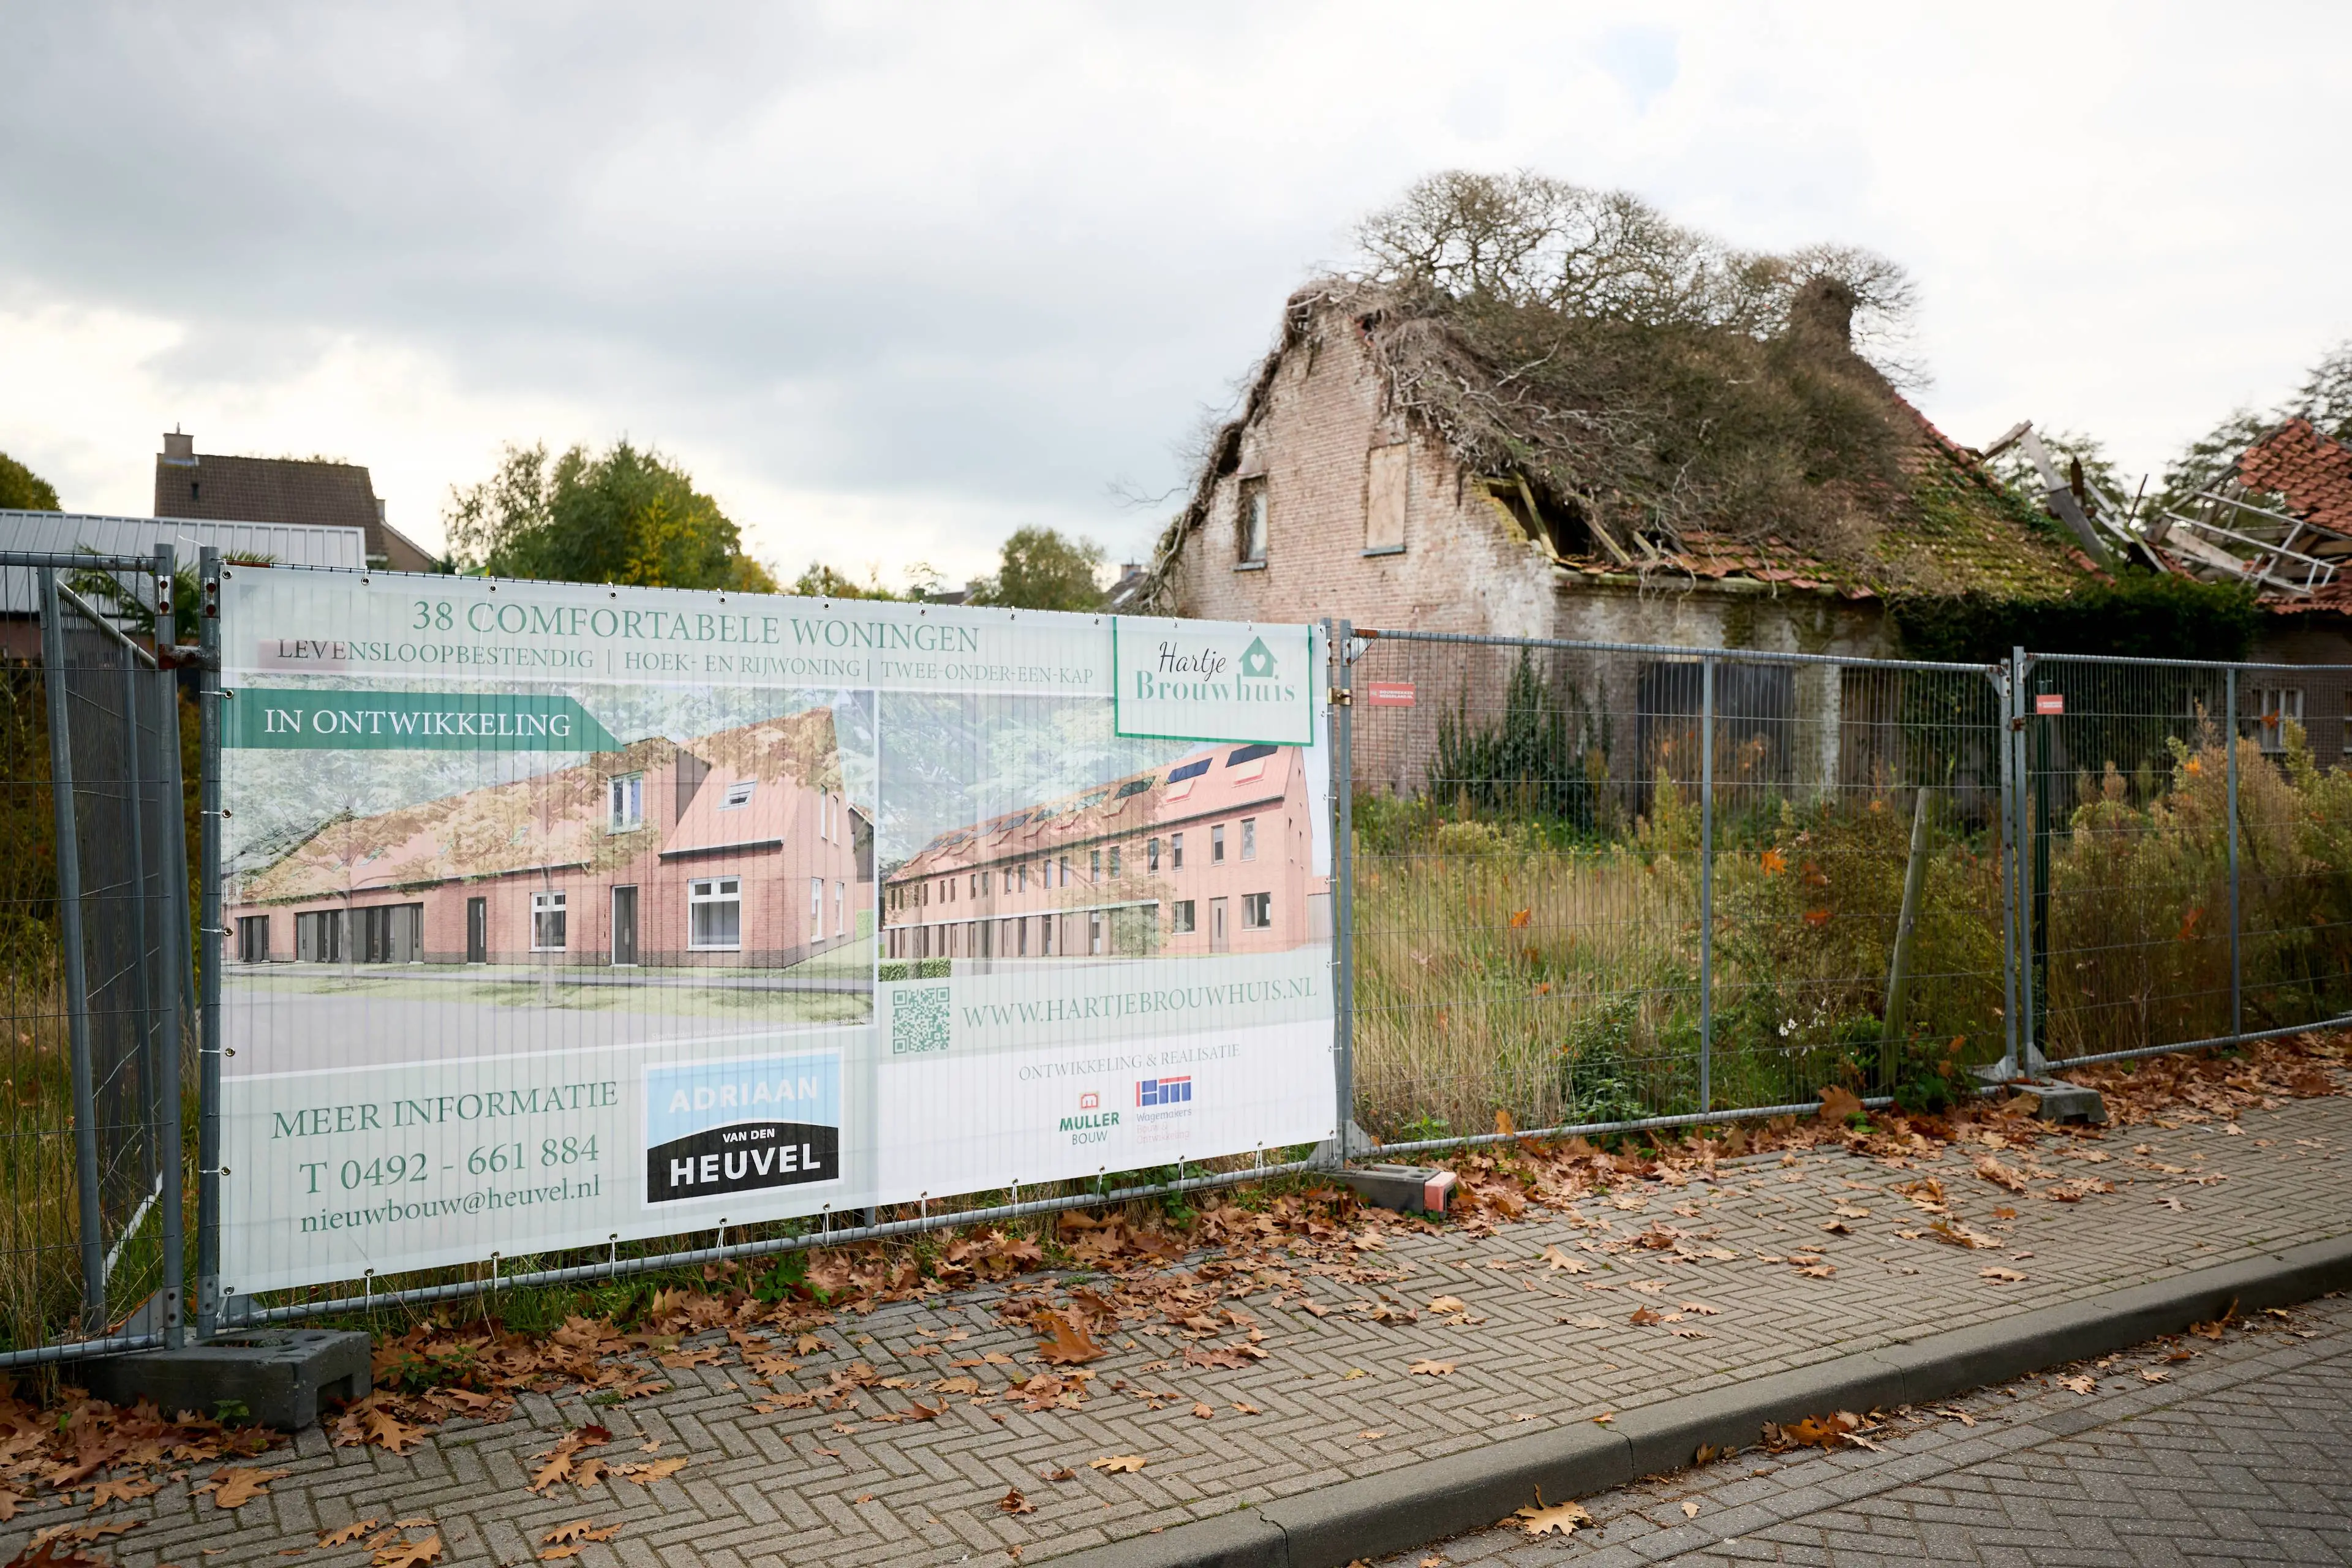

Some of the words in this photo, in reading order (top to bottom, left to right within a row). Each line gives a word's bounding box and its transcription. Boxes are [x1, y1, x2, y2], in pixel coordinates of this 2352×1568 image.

[412, 600, 453, 630] 38
[467, 602, 780, 644] COMFORTABELE
[791, 617, 980, 653] WONINGEN
[277, 638, 594, 668] LEVENSLOOPBESTENDIG
[625, 652, 697, 672] HOEK-
[706, 655, 733, 673] EN
[741, 655, 861, 678] RIJWONING
[882, 661, 1094, 685] TWEE-ONDER-EEN-KAP
[1158, 641, 1227, 682] Hartje
[1136, 670, 1295, 703] Brouwhuis
[265, 709, 303, 733] IN
[312, 709, 571, 737] ONTWIKKELING
[962, 976, 1317, 1028] WWW.HARTJEBROUWHUIS.NL
[1019, 1054, 1143, 1081] ONTWIKKELING
[1147, 1052, 1157, 1067] &
[1161, 1043, 1241, 1065] REALISATIE
[271, 1102, 382, 1140] MEER
[392, 1080, 619, 1129] INFORMATIE
[669, 1076, 818, 1114] ADRIAAN
[1059, 1112, 1120, 1132] MULLER
[1136, 1108, 1192, 1124] Wagemakers
[1137, 1125, 1159, 1133] Bouw
[723, 1133, 746, 1143] VAN
[750, 1128, 775, 1140] DEN
[1072, 1131, 1108, 1145] BOUW
[1137, 1130, 1190, 1145] Ontwikkeling
[300, 1161, 327, 1194] T
[341, 1153, 428, 1191] 0492
[467, 1142, 526, 1177] 661
[540, 1133, 600, 1167] 884
[670, 1143, 821, 1188] HEUVEL
[300, 1174, 601, 1234] nieuwbouw@heuvel.nl
